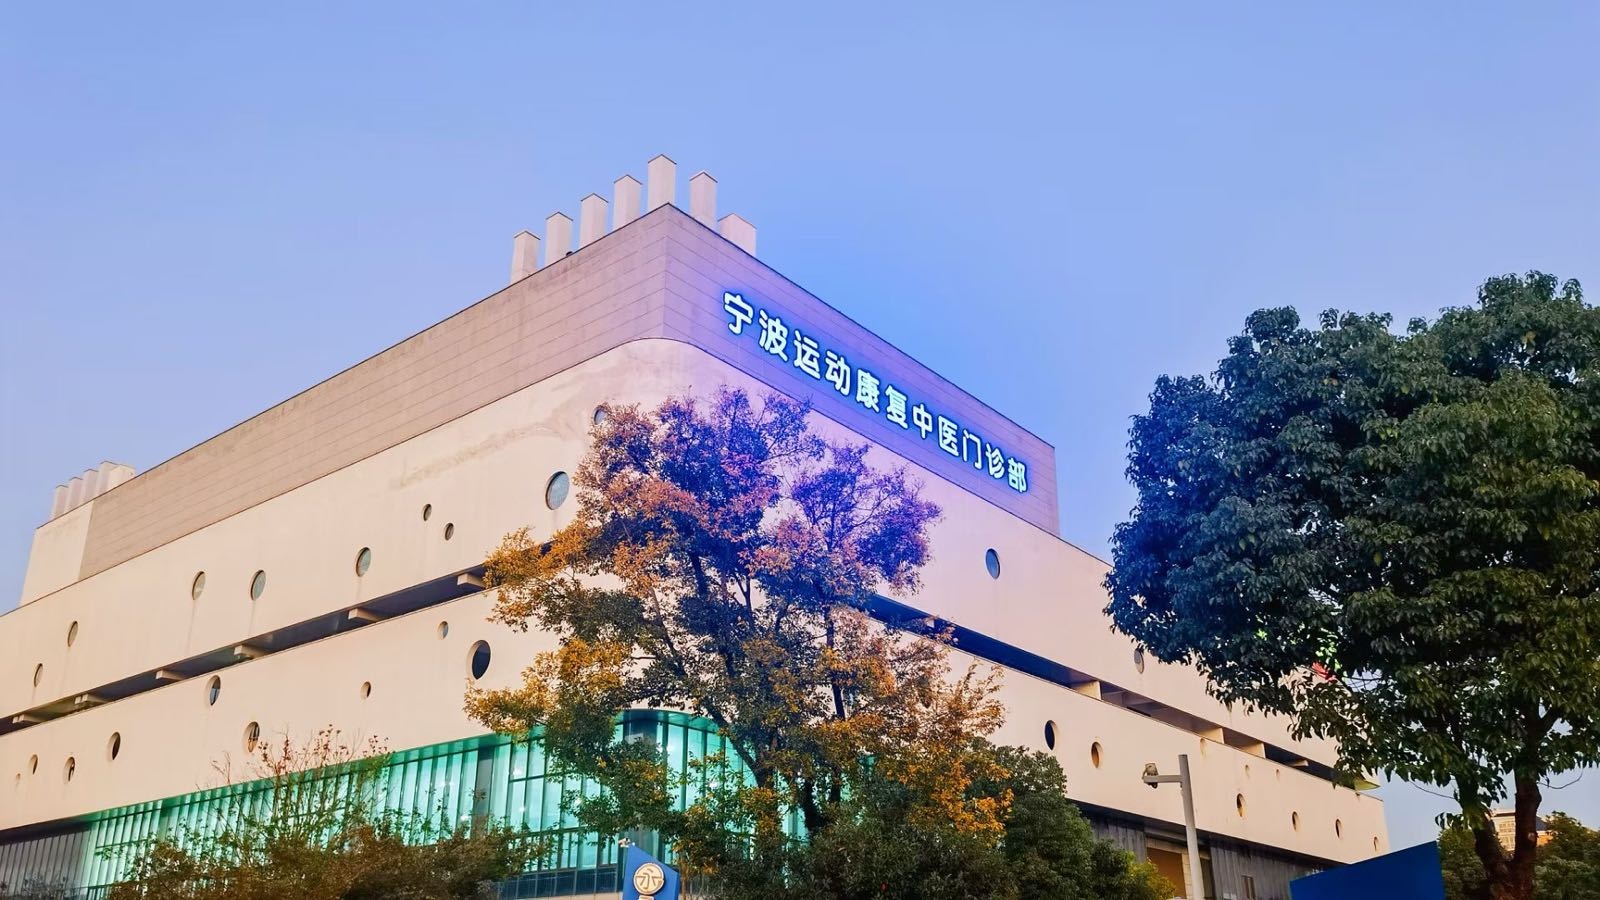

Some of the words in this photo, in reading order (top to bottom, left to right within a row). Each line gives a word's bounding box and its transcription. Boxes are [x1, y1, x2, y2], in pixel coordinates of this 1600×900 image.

[723, 292, 1029, 493] 宁波运动康复中医门诊部
